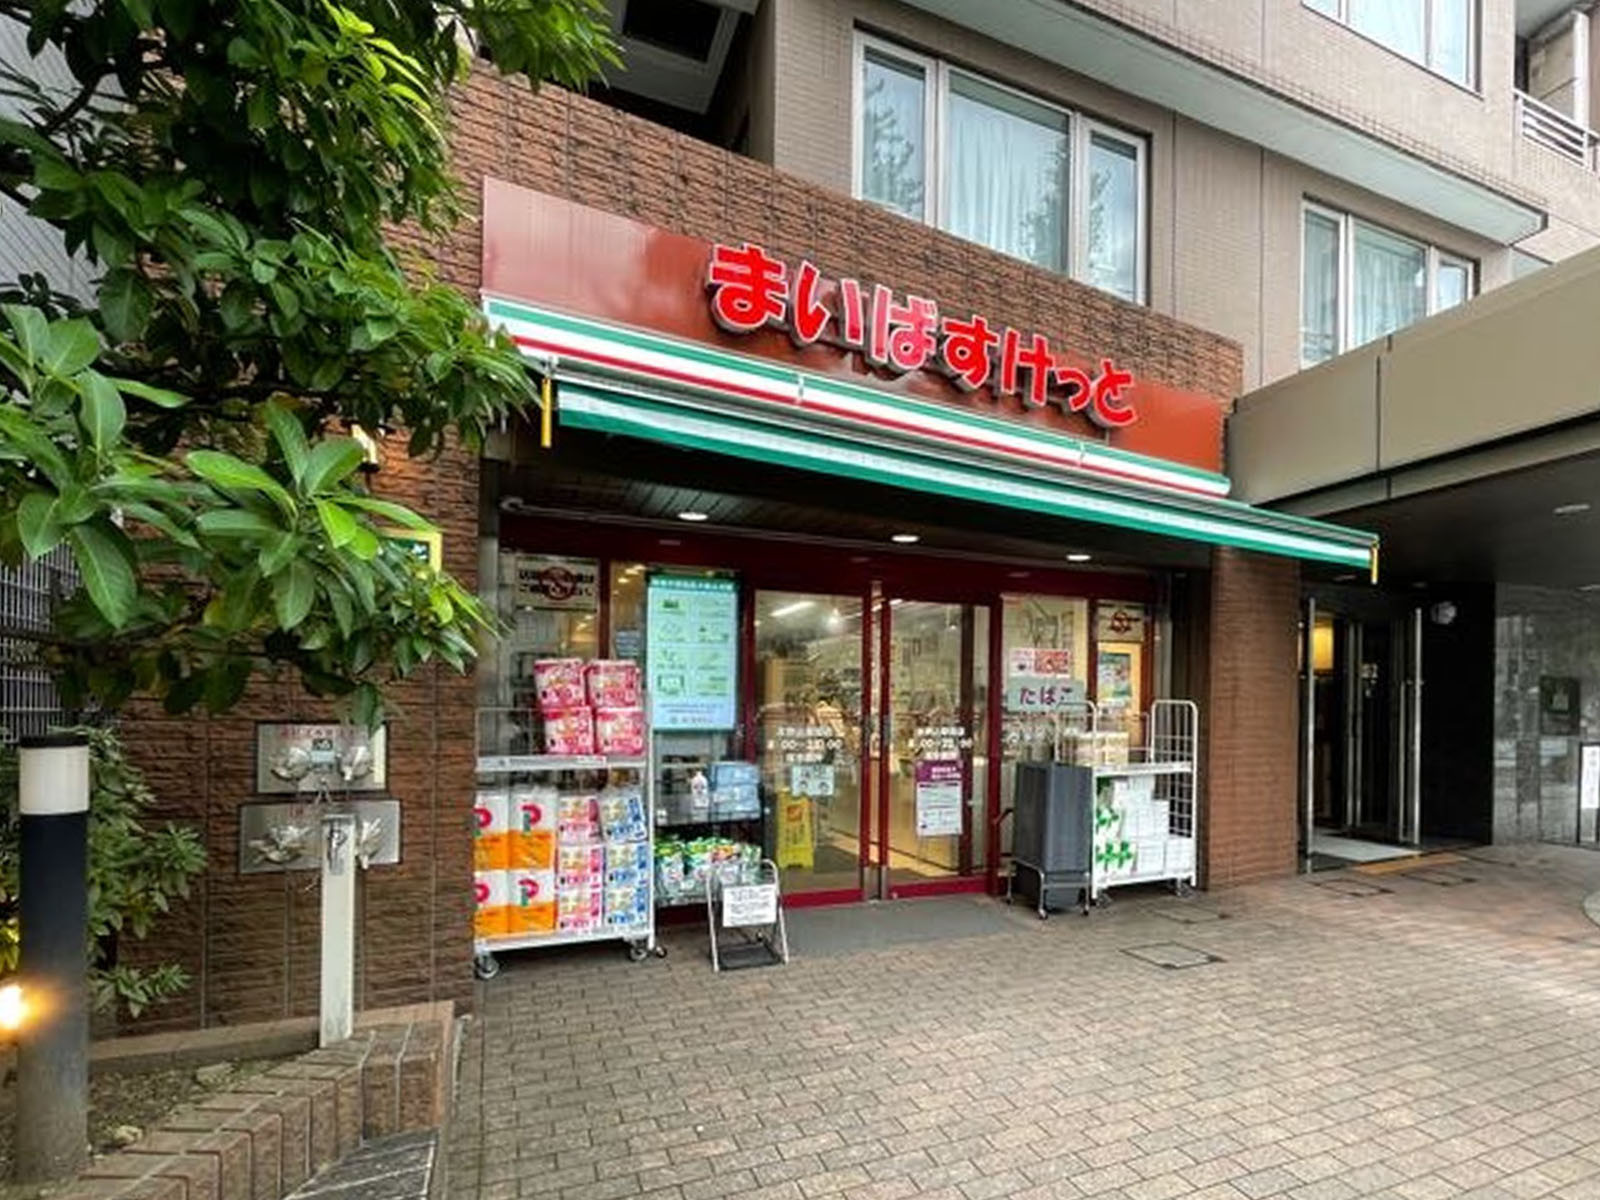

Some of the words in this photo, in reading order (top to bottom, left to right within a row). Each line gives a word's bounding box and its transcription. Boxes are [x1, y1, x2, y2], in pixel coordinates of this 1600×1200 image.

[708, 242, 1138, 427] まいばすけっと
[1019, 685, 1073, 705] たばこ
